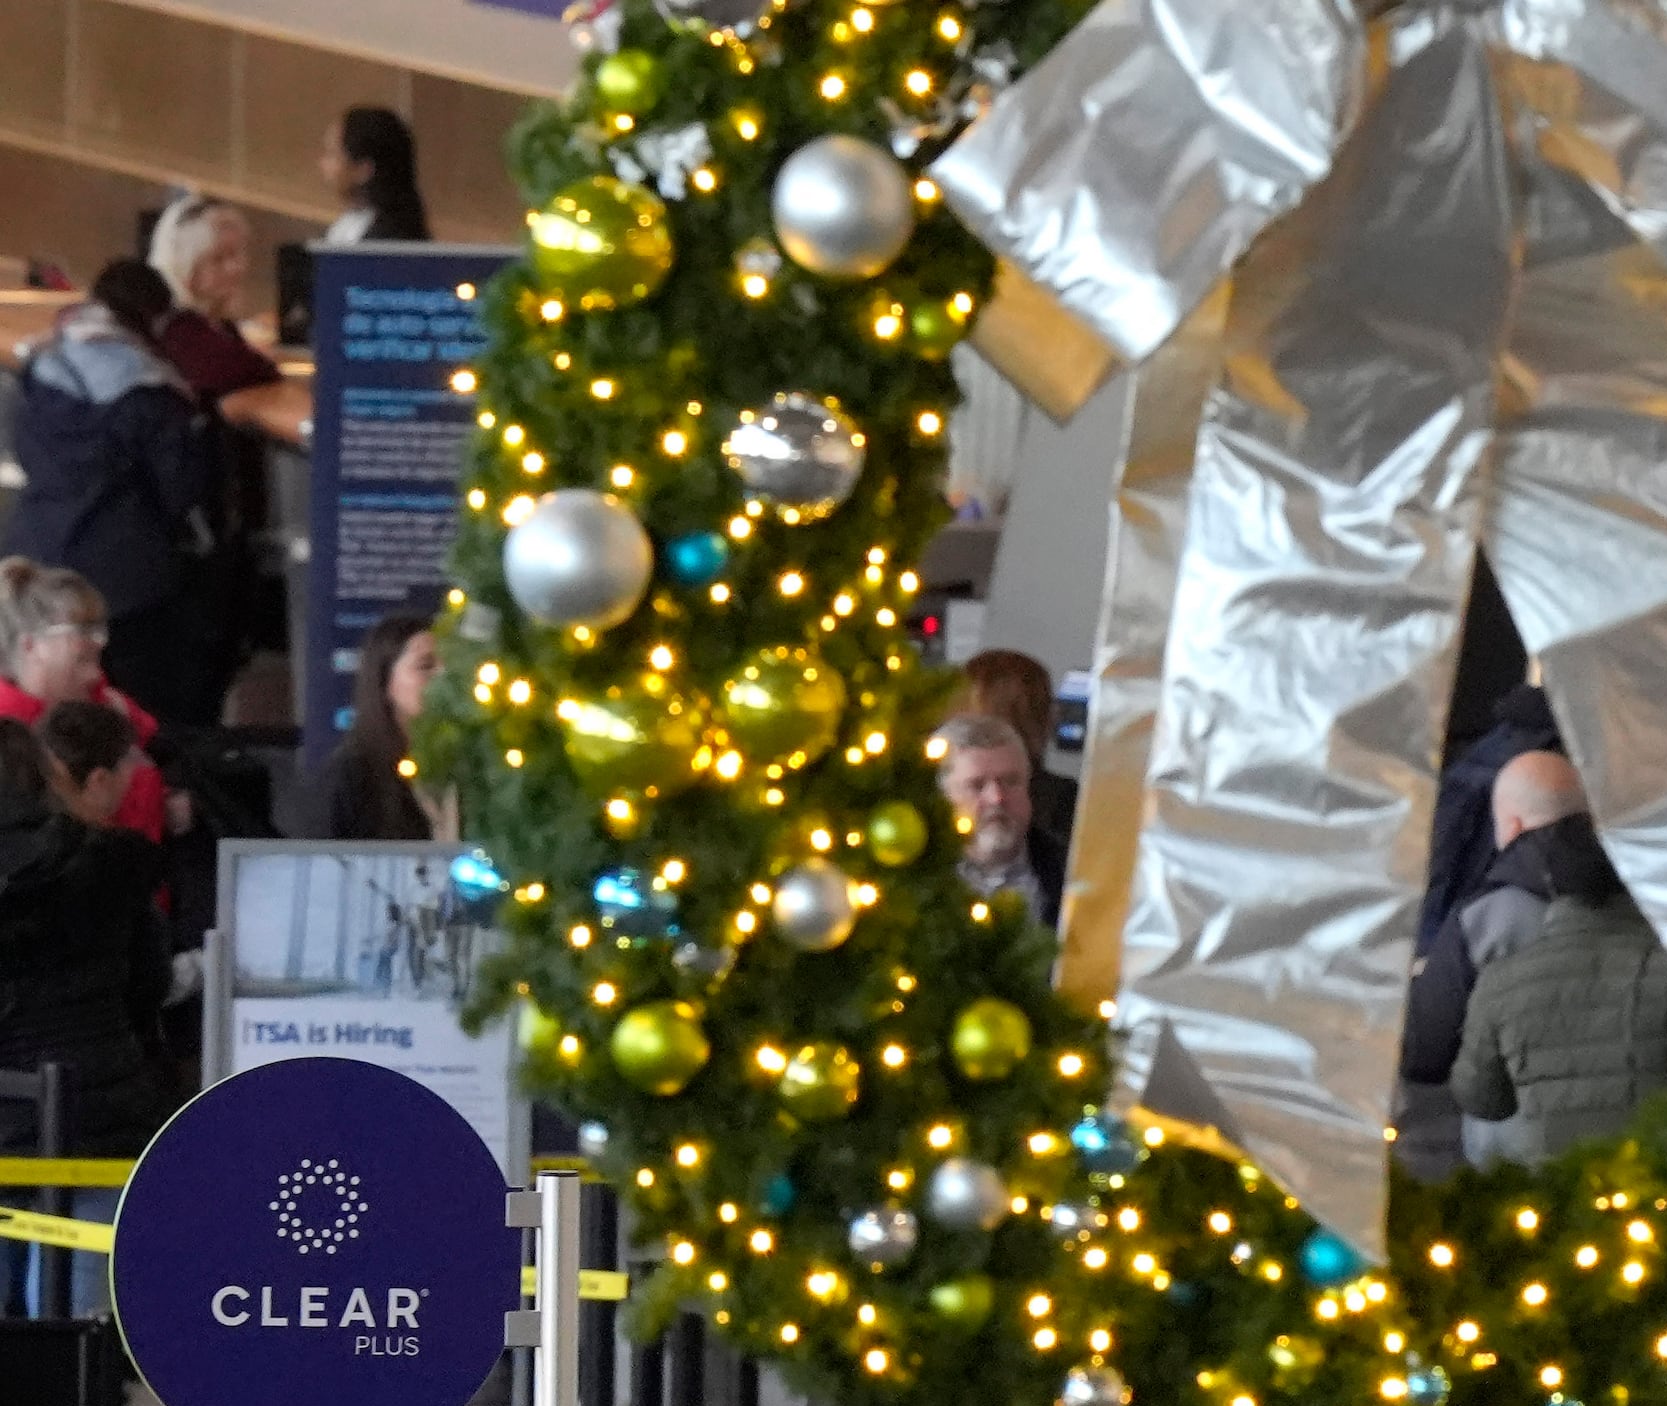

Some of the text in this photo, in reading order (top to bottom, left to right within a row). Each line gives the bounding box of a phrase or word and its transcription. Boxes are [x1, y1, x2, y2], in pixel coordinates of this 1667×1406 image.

[255, 1021, 413, 1048] TSA is Hiring
[211, 1285, 420, 1328] CLEAR
[355, 1336, 420, 1356] PLUS
